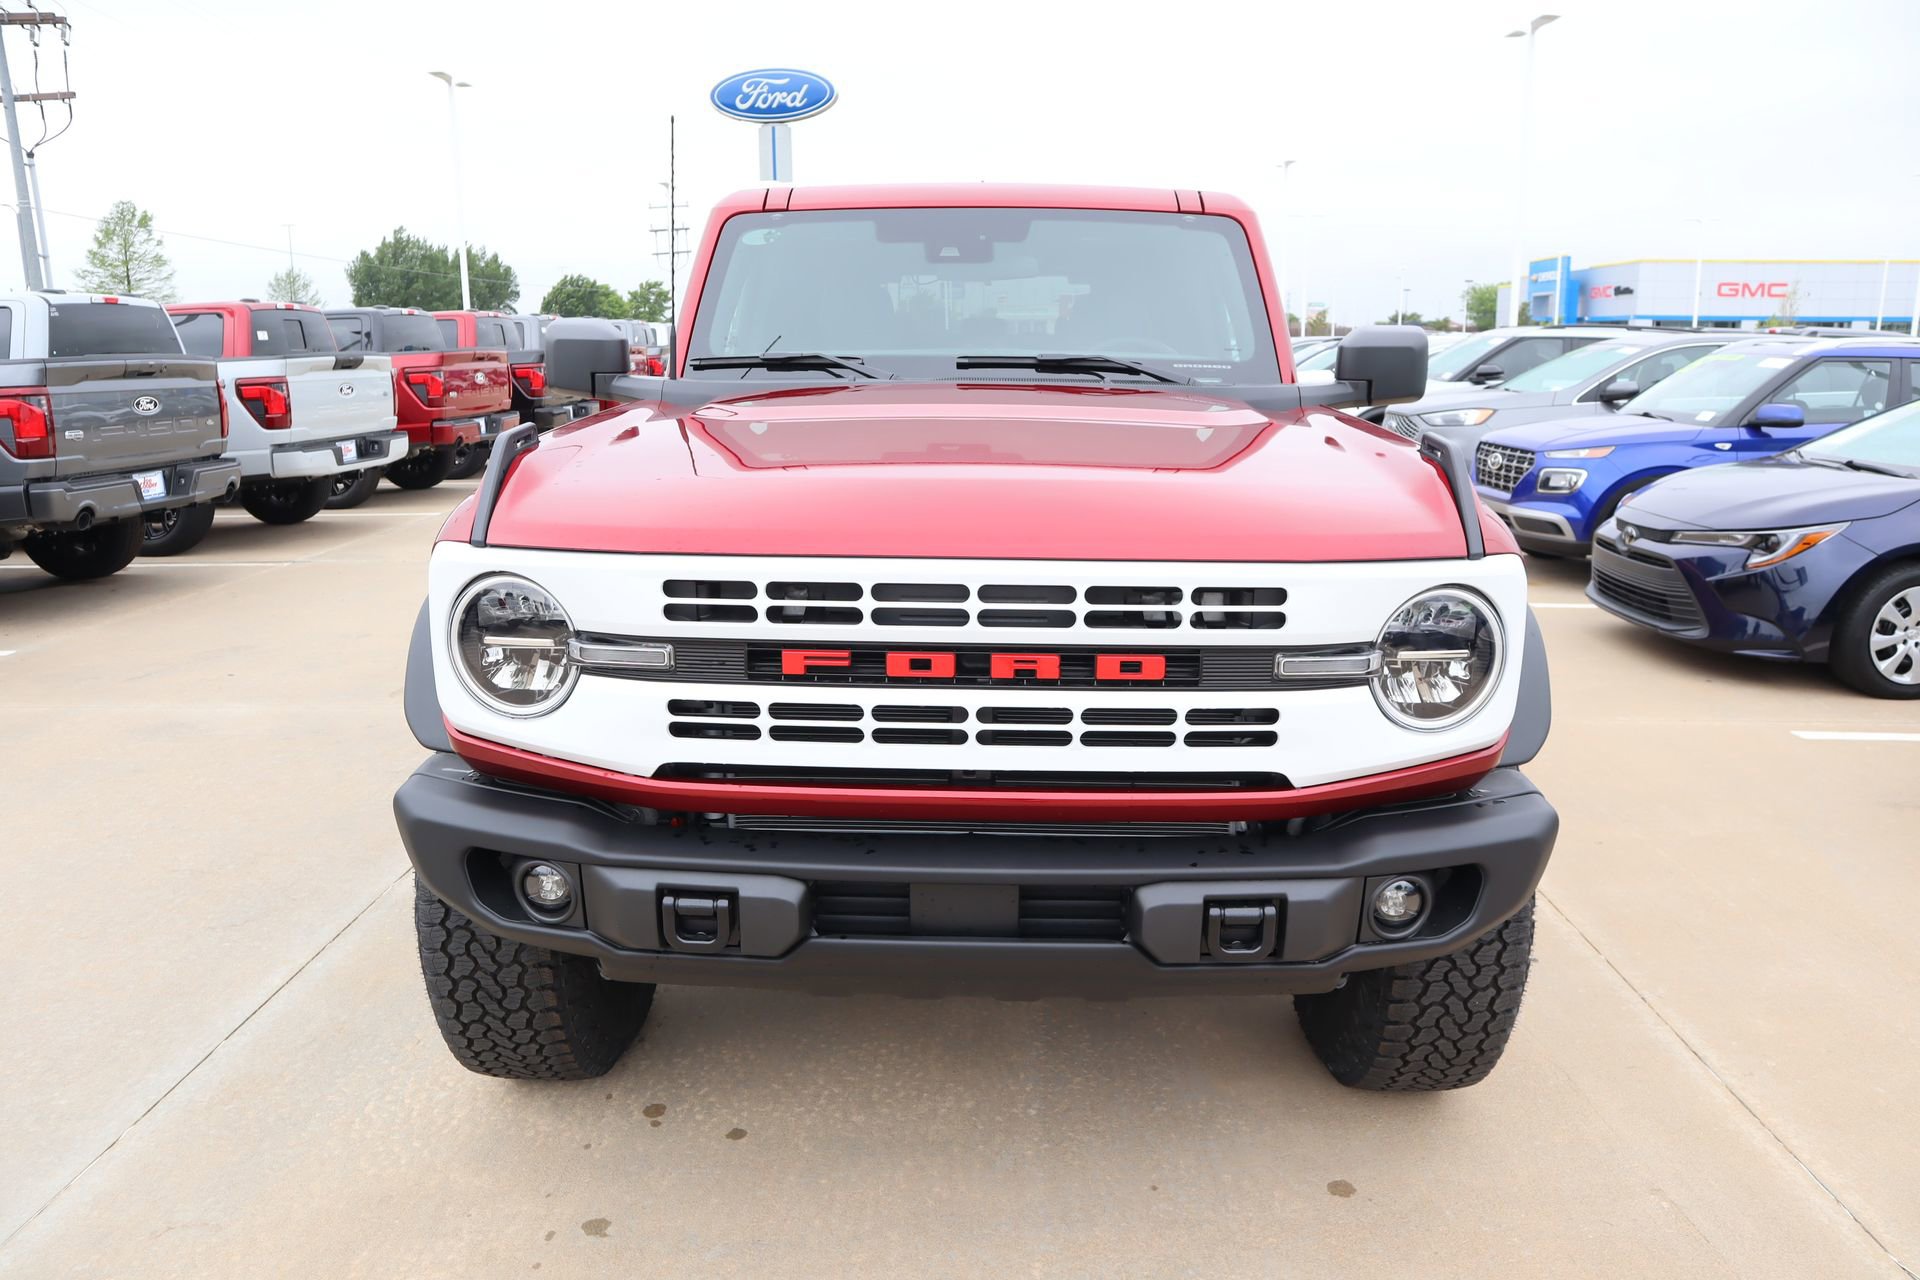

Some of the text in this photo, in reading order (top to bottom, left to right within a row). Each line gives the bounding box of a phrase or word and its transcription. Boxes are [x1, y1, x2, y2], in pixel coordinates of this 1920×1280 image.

[735, 77, 809, 110] Ford
[1717, 282, 1788, 298] GMC
[139, 399, 155, 411] Ford
[781, 649, 1166, 680] FORD
